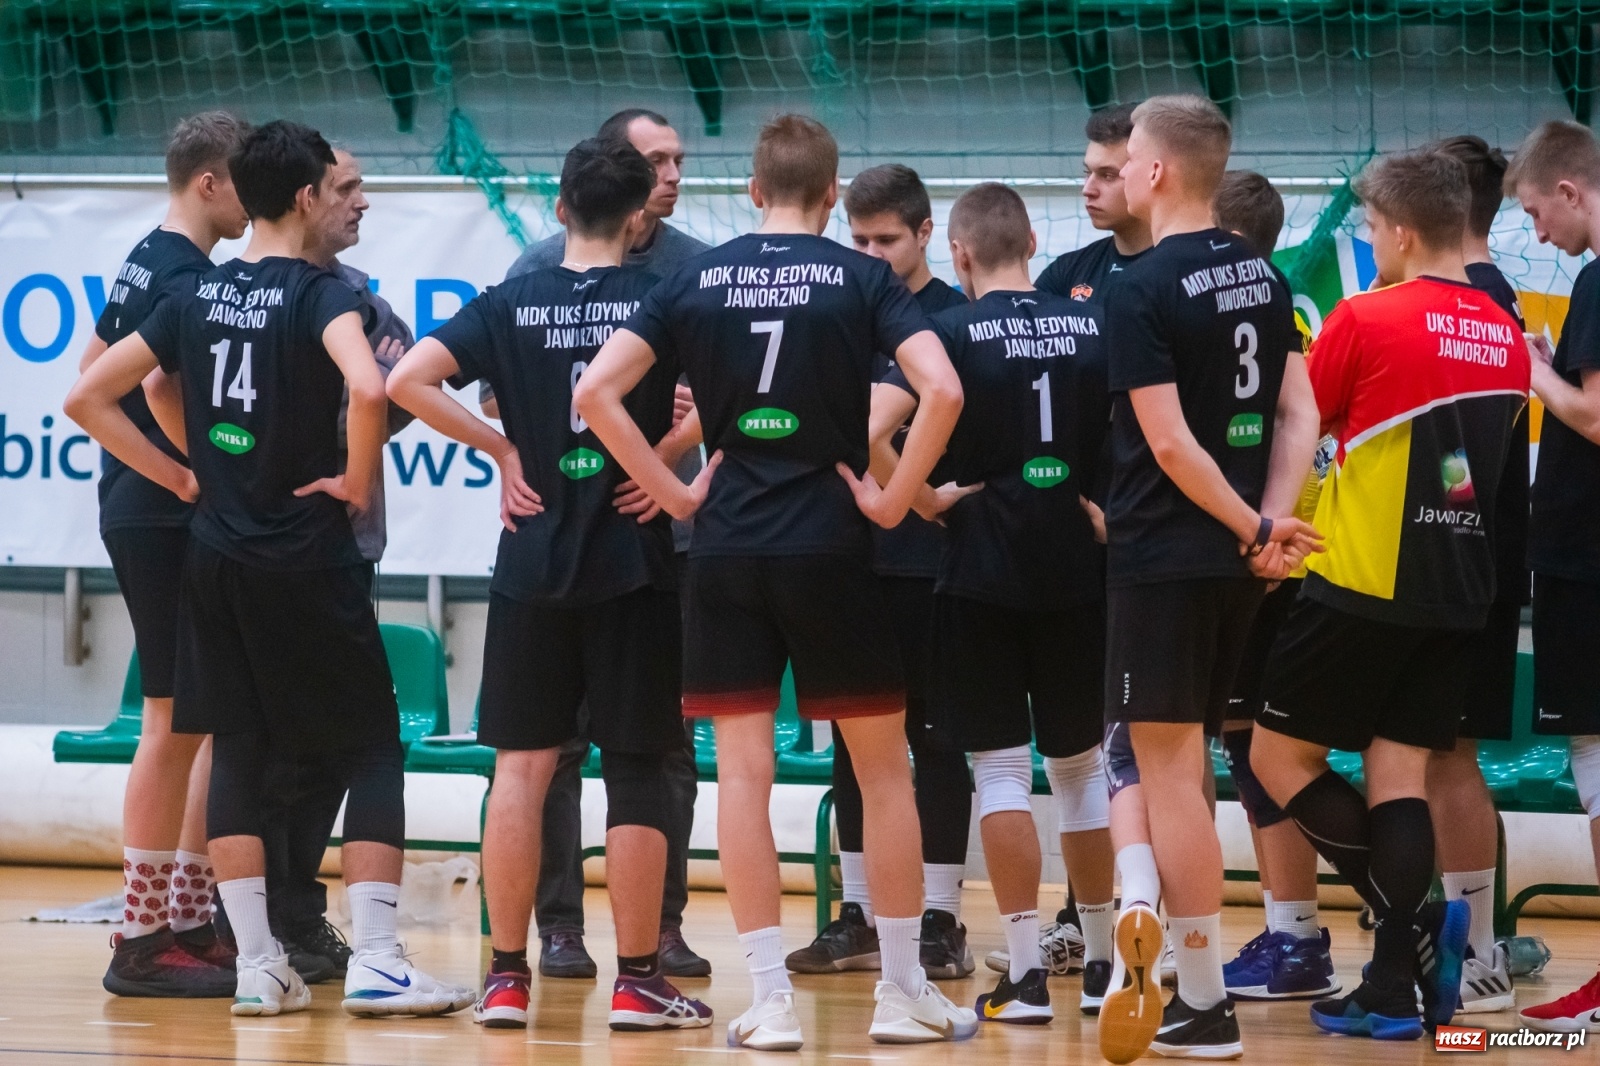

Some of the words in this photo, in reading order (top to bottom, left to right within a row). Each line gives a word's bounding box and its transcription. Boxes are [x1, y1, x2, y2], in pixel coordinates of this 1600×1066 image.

[699, 265, 734, 289] MDK
[737, 266, 770, 286] UKS
[772, 263, 844, 286] JEDYNKA
[1181, 268, 1215, 298] MDK
[1212, 264, 1236, 288] UKS
[724, 285, 811, 308] JAWORZNO
[516, 305, 551, 327] MDK
[553, 304, 582, 325] UKS
[968, 318, 1006, 342] MDK
[1033, 315, 1100, 338] JEDYNKA
[1425, 311, 1455, 335] UKS
[1457, 317, 1514, 346] JEDYNKA
[750, 320, 784, 393] 7
[1234, 322, 1260, 399] 3
[1437, 336, 1508, 369] JAWORZNO
[209, 337, 257, 413] 14
[1032, 371, 1054, 443] 1
[744, 417, 793, 430] MIKI
[215, 430, 249, 447] MIKI
[565, 457, 598, 470] IKI
[1027, 466, 1063, 479] MIKI
[1123, 673, 1131, 705] KIPSTA
